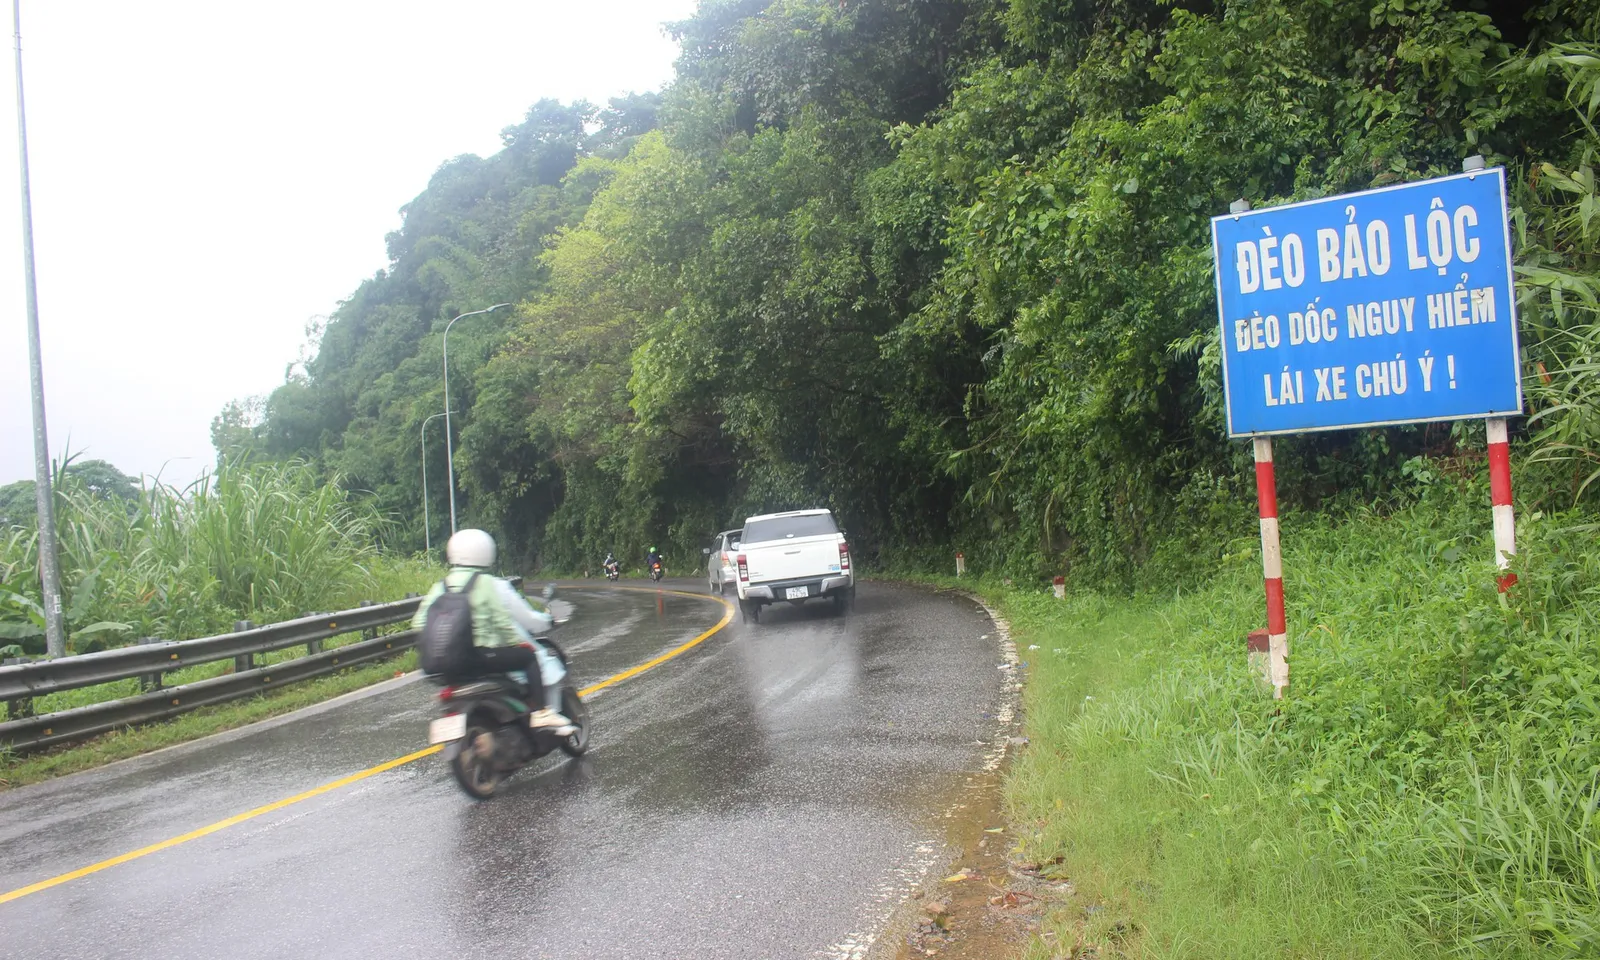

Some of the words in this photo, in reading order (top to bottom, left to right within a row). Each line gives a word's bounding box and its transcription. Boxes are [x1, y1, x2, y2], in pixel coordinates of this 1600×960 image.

[1236, 226, 1306, 295] ĐÈO
[1316, 205, 1392, 283] BẢO
[1404, 197, 1481, 276] LỘC
[1234, 311, 1281, 353] ĐÈO
[1288, 297, 1338, 346] DỐC
[1346, 297, 1416, 339] NGUY
[1426, 273, 1496, 330] HIỂM
[1263, 366, 1304, 407] LÁI
[1313, 366, 1348, 402] XE
[1355, 353, 1408, 399] CHÚ
[1417, 350, 1434, 392] Ý
[1447, 354, 1457, 390] !
